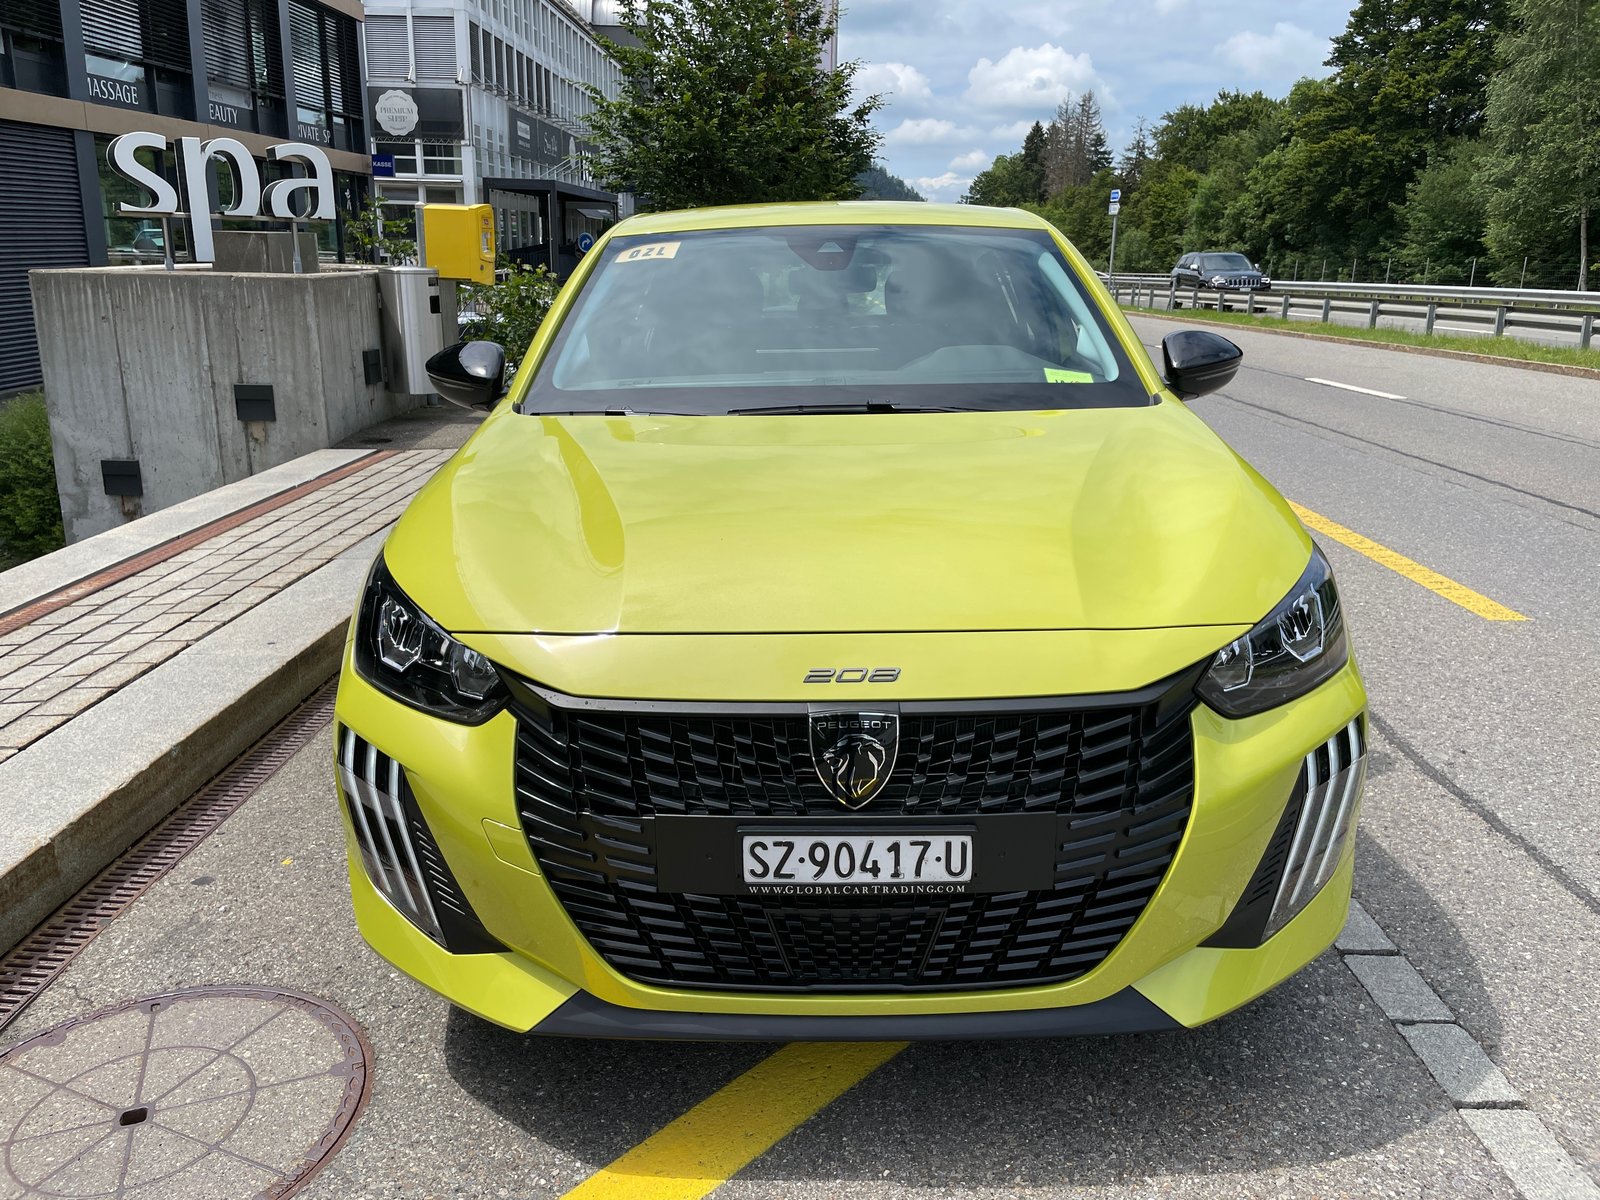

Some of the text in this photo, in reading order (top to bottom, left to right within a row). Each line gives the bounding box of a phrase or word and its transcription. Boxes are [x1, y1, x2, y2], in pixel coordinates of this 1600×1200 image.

[372, 160, 392, 168] KASSE
[106, 131, 337, 263] spa
[803, 667, 902, 684] 208
[817, 720, 892, 730] PEUGEOT
